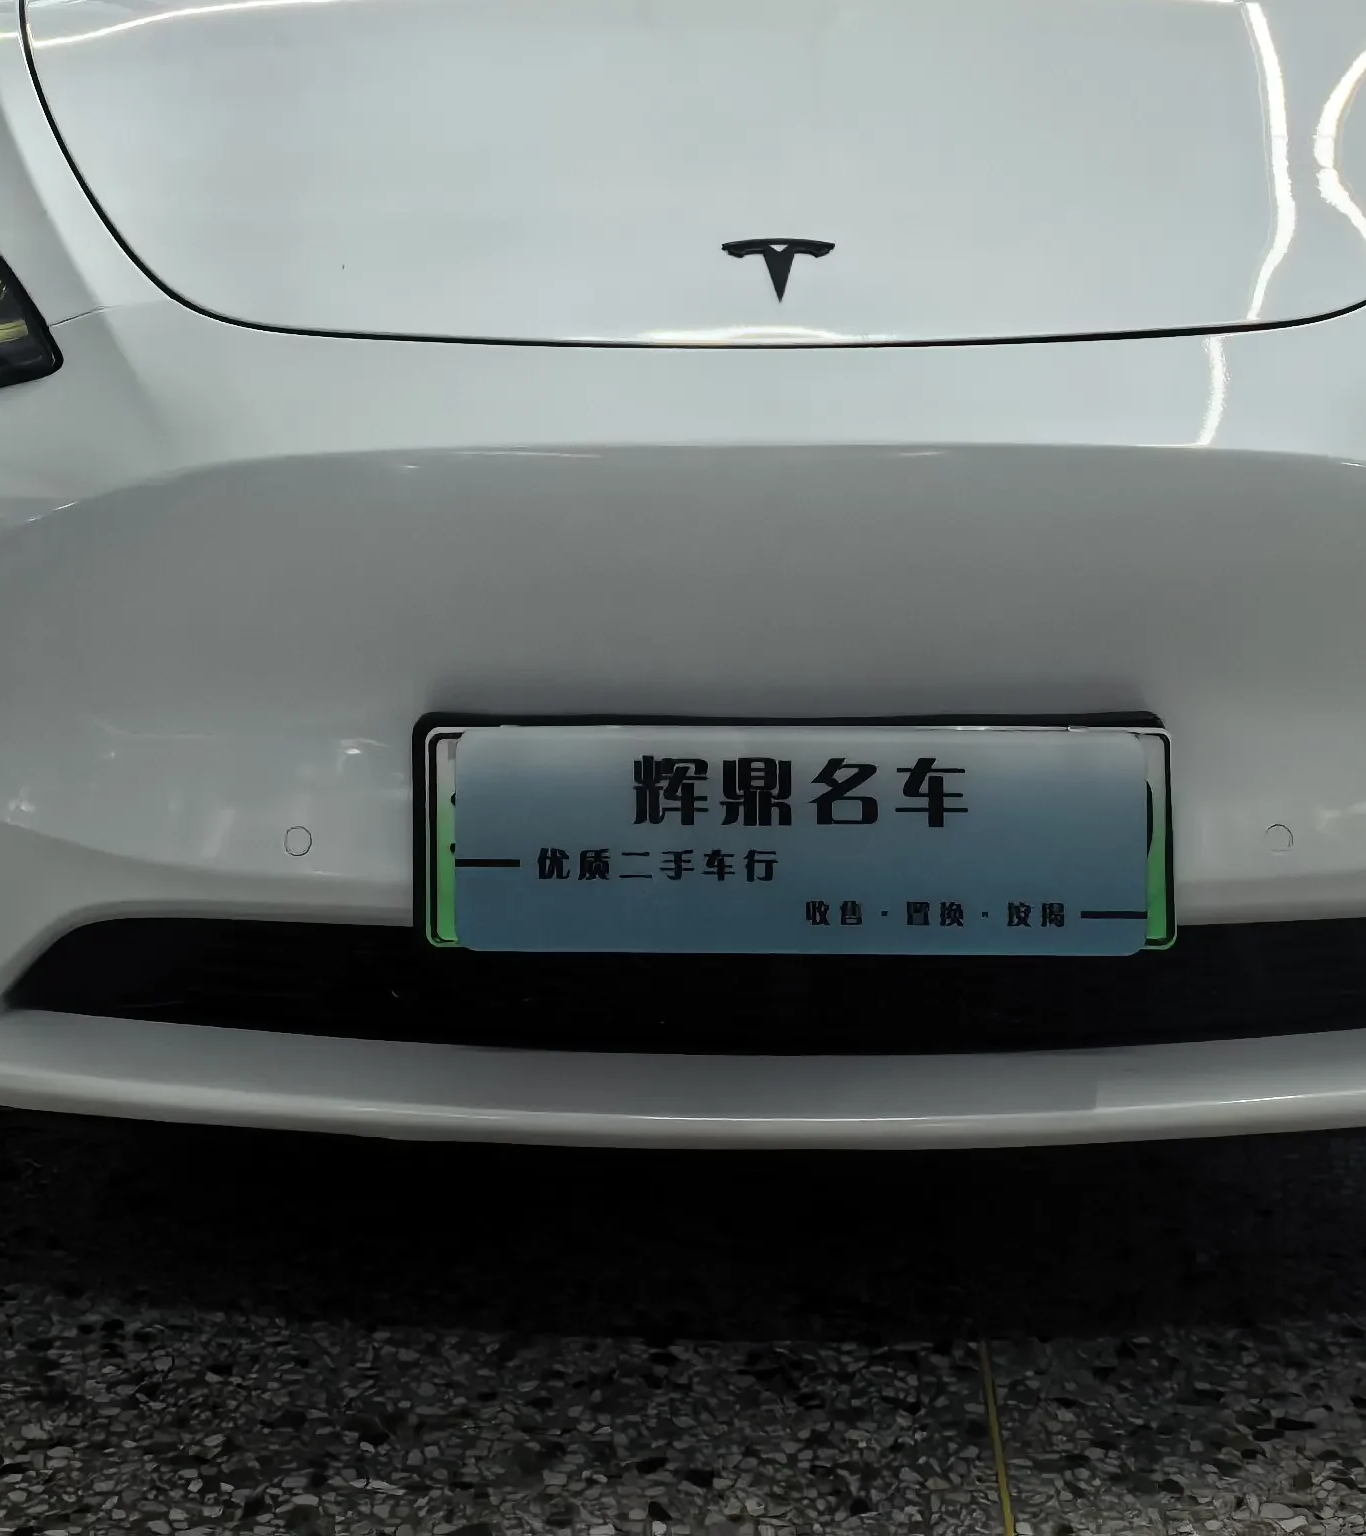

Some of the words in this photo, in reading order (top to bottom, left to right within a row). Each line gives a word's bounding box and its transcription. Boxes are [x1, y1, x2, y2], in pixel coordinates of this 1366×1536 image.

[633, 754, 970, 830] 辉鼎名车
[536, 847, 780, 883] 优质二手车行
